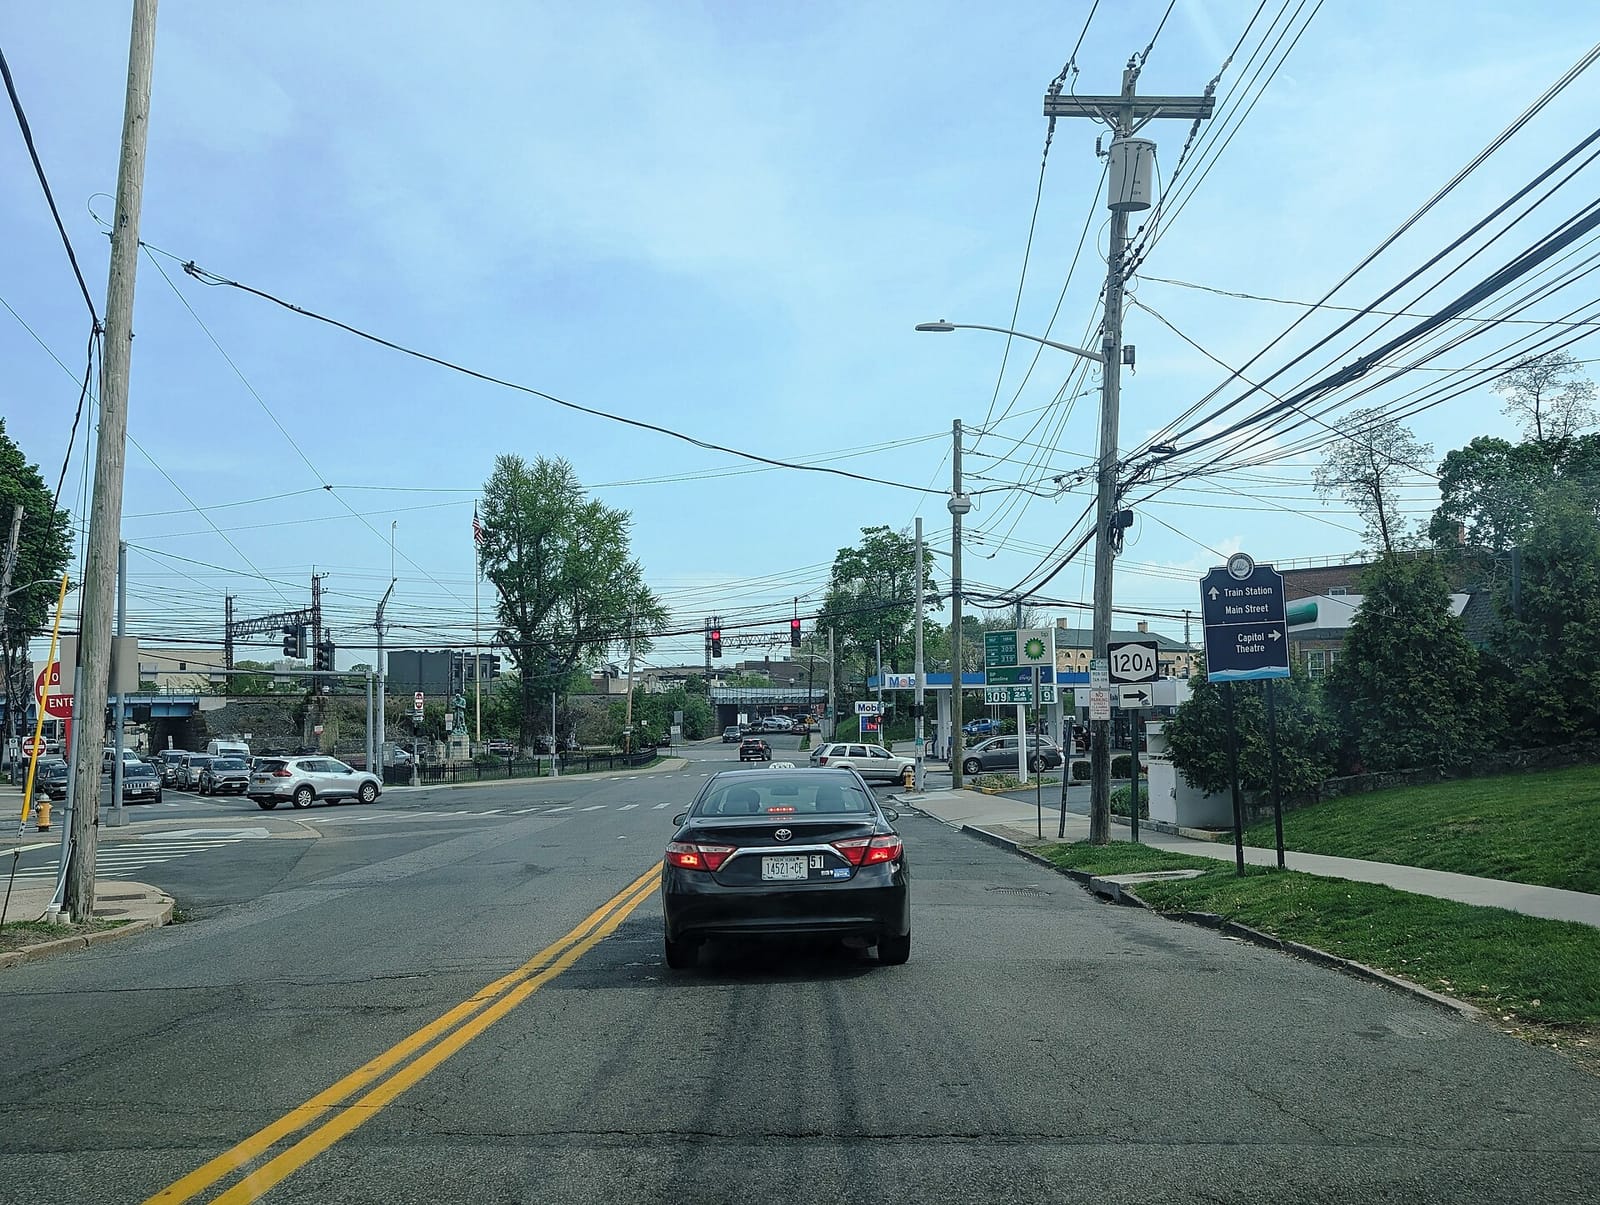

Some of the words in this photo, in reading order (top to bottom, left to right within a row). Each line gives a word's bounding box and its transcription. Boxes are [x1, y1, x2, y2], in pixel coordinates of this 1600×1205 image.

[1224, 587, 1243, 597] Train
[1245, 586, 1273, 596] Station
[1225, 605, 1243, 615] Main
[1245, 604, 1269, 614] Street
[1237, 632, 1265, 644] Capitol
[1235, 643, 1265, 653] Theatre
[1113, 653, 1154, 673] 120A
[889, 676, 916, 688] Mob
[49, 697, 75, 708] ENTE
[987, 692, 1007, 703] 309
[857, 703, 880, 712] Mobi
[810, 855, 823, 868] 51
